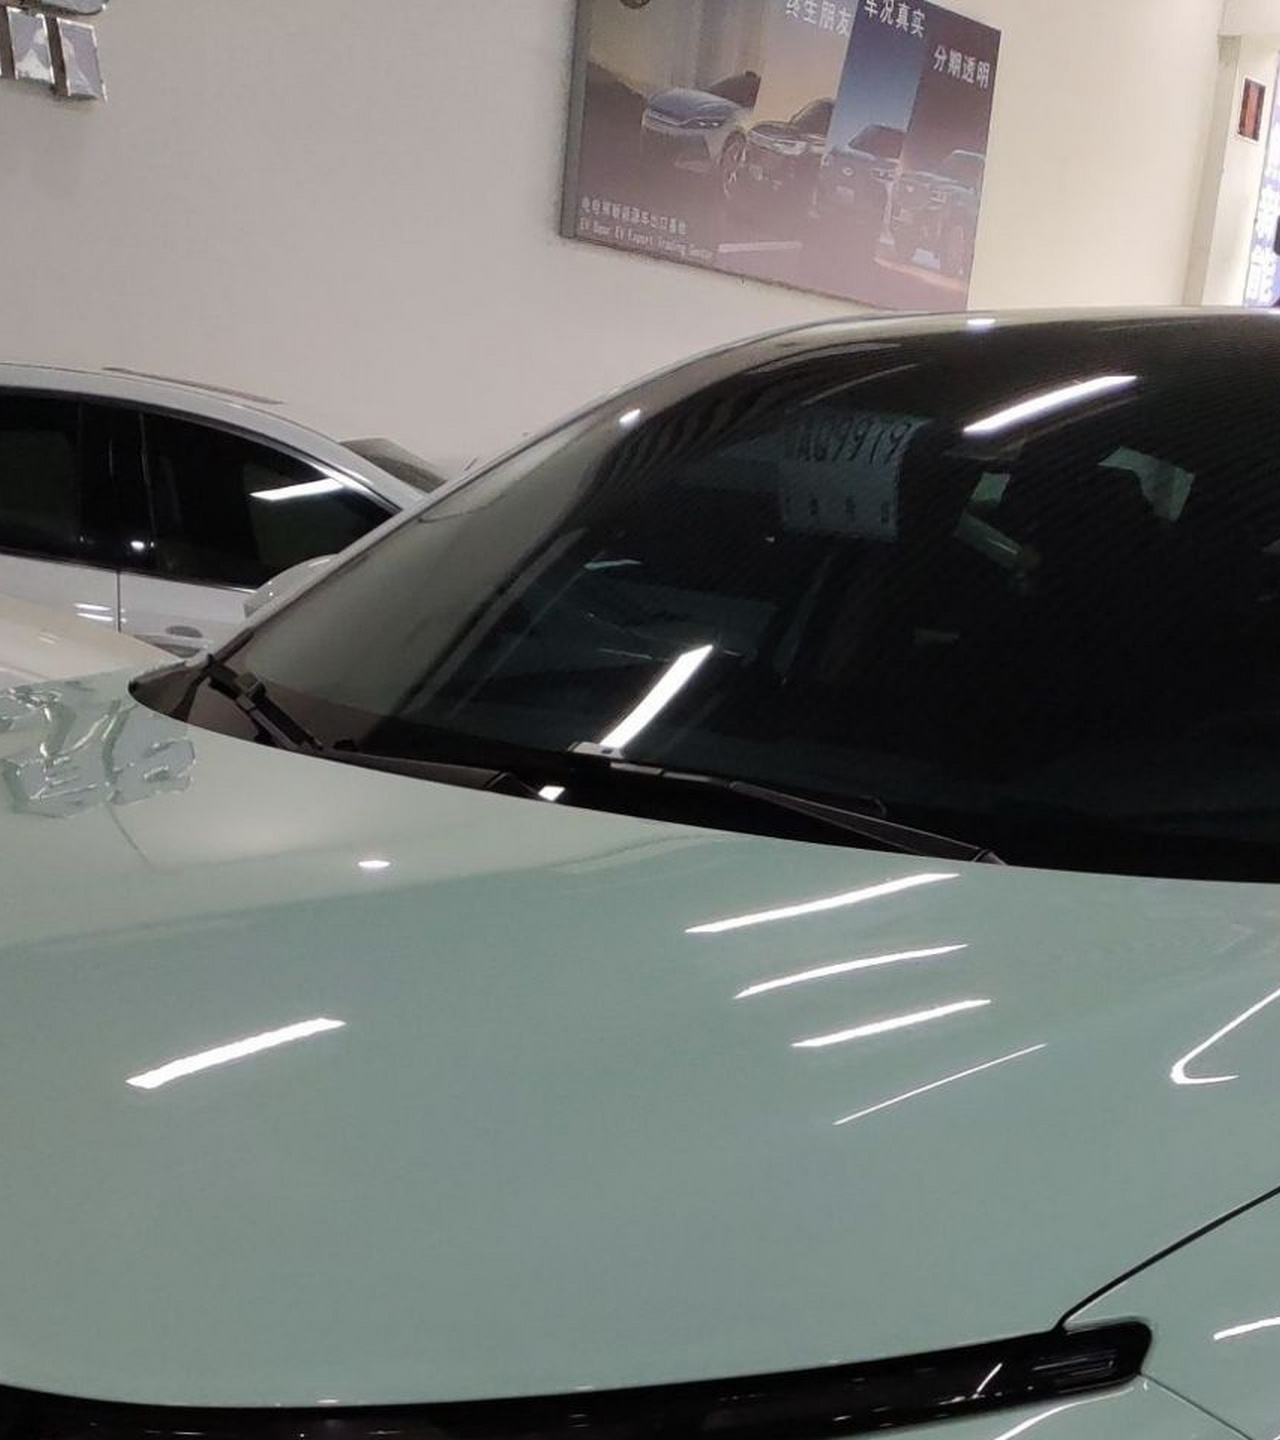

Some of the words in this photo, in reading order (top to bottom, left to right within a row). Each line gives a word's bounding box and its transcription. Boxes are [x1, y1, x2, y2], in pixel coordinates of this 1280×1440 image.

[863, 0, 926, 39] 车况真实
[932, 44, 991, 89] 分期透明
